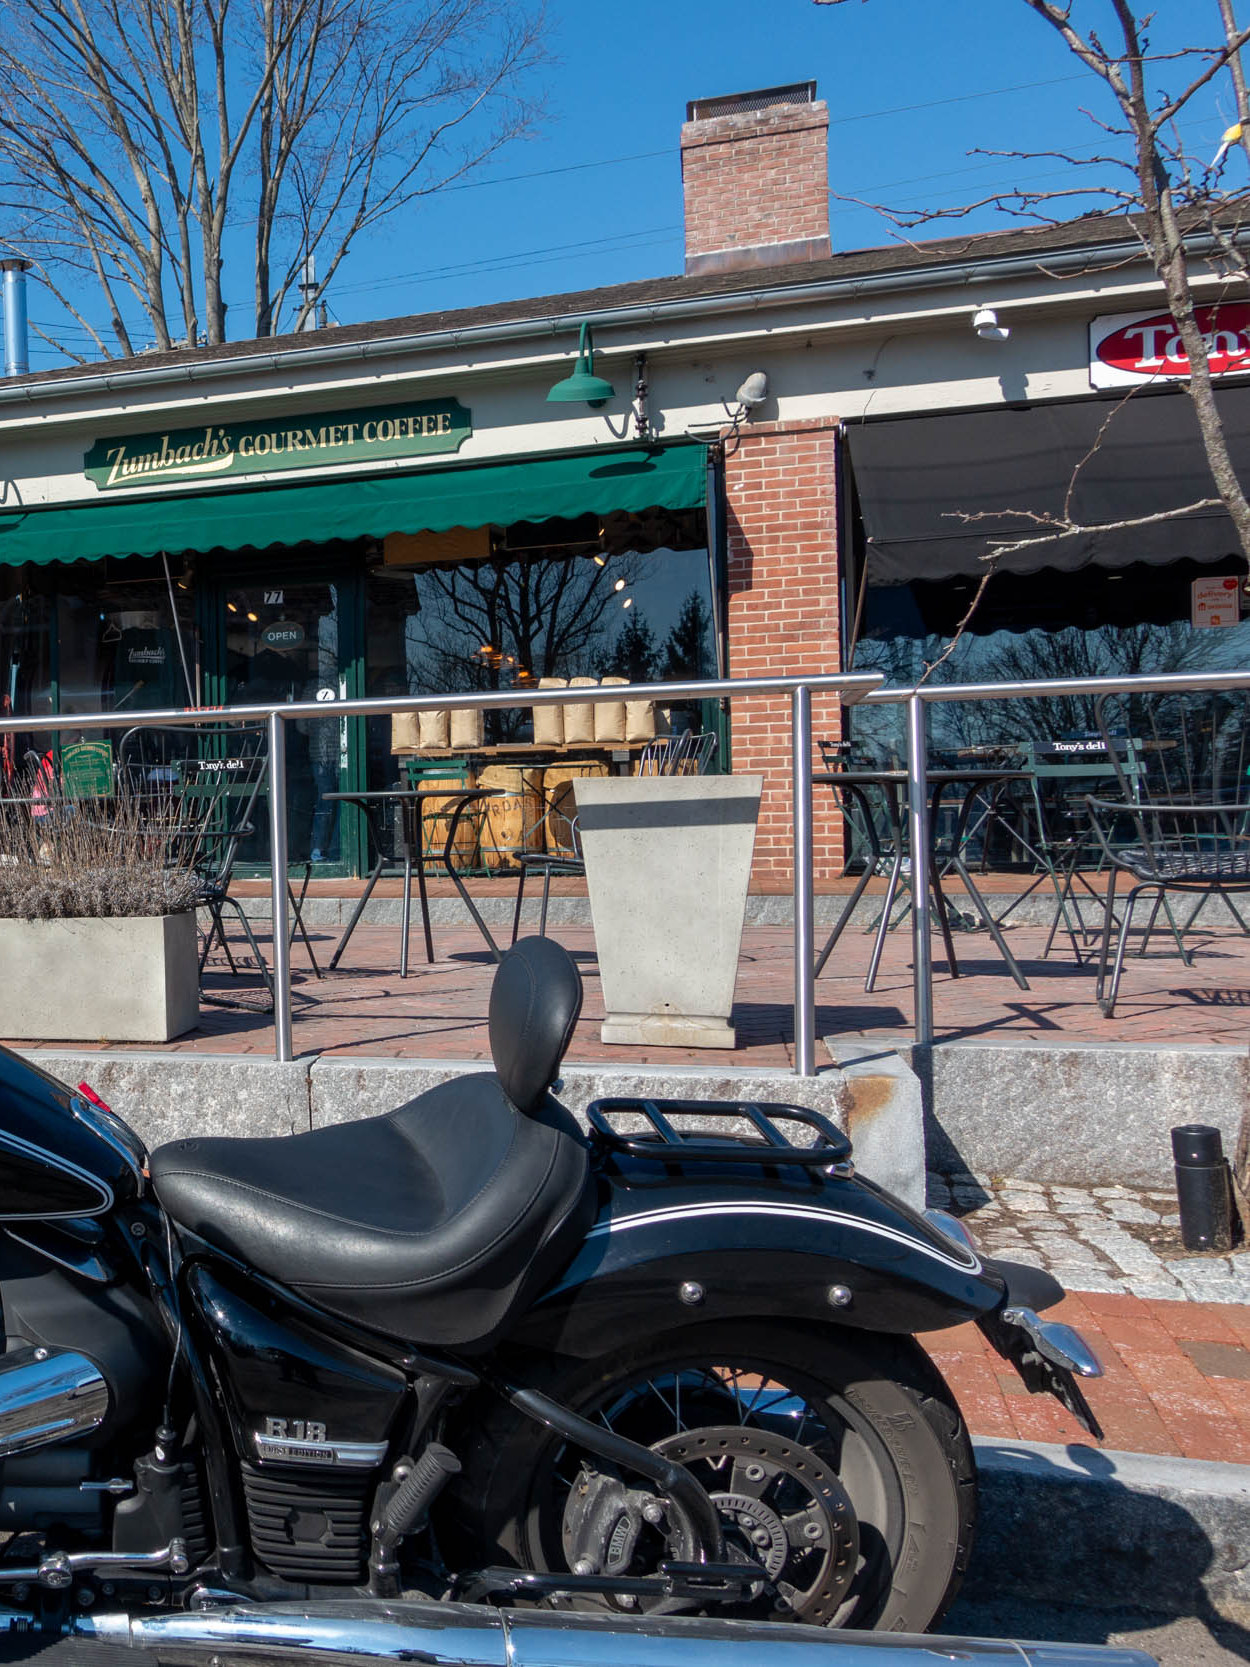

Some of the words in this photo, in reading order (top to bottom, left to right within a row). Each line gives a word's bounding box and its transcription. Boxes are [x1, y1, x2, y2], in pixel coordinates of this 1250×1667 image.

[1123, 323, 1250, 368] Ton
[106, 427, 234, 486] Zumbach's
[239, 423, 359, 457] GOURMET
[362, 413, 452, 443] COFFEE
[265, 591, 282, 604] 77
[268, 631, 297, 641] OPEN
[1052, 742, 1085, 752] Tony's
[1086, 741, 1106, 750] deli
[611, 1526, 628, 1554] BMW
